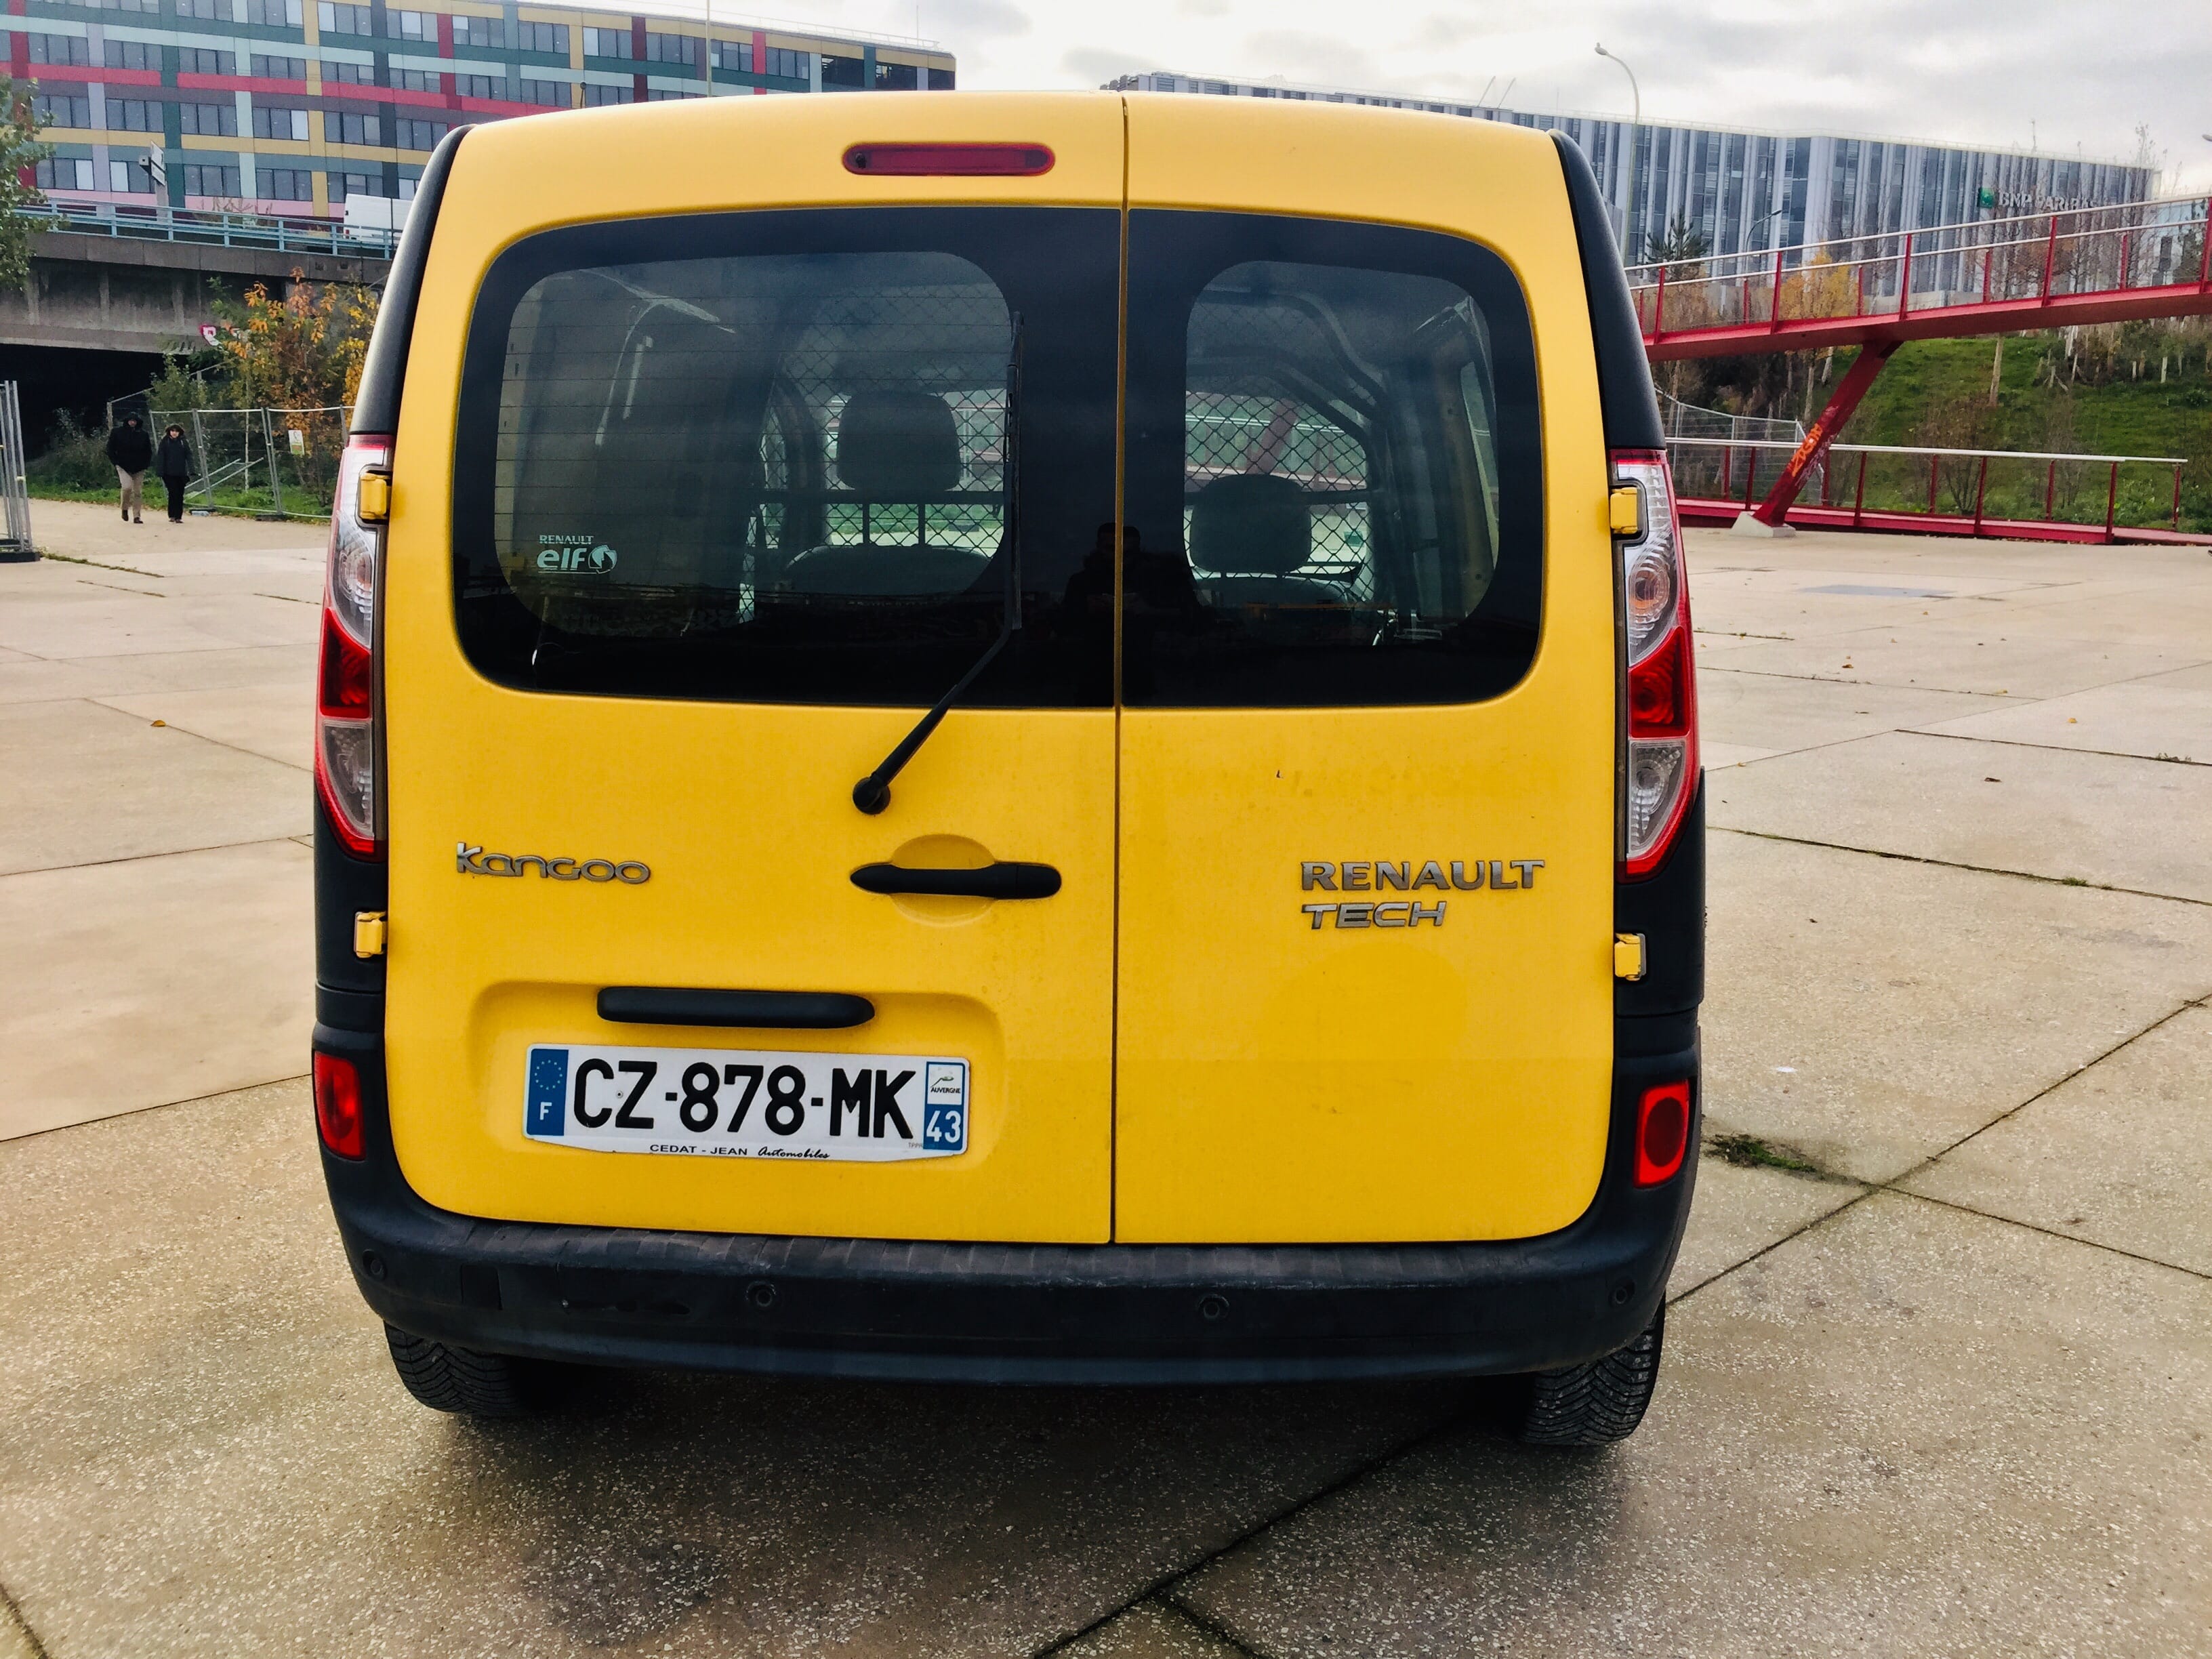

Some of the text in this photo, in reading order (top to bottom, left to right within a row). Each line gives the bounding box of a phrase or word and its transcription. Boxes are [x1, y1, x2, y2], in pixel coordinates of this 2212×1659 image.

[1999, 191, 2032, 207] BNP
[539, 535, 594, 544] RENAULT
[537, 548, 588, 571] elf
[1300, 859, 1545, 890] RENAULT
[1301, 901, 1448, 930] TECH
[573, 1058, 916, 1139] CZ-878-MK
[539, 1101, 552, 1120] F
[926, 1110, 962, 1143] 43
[649, 1144, 697, 1153] CEDAT
[710, 1147, 748, 1155] JEAN
[758, 1146, 830, 1159] Automobiles
